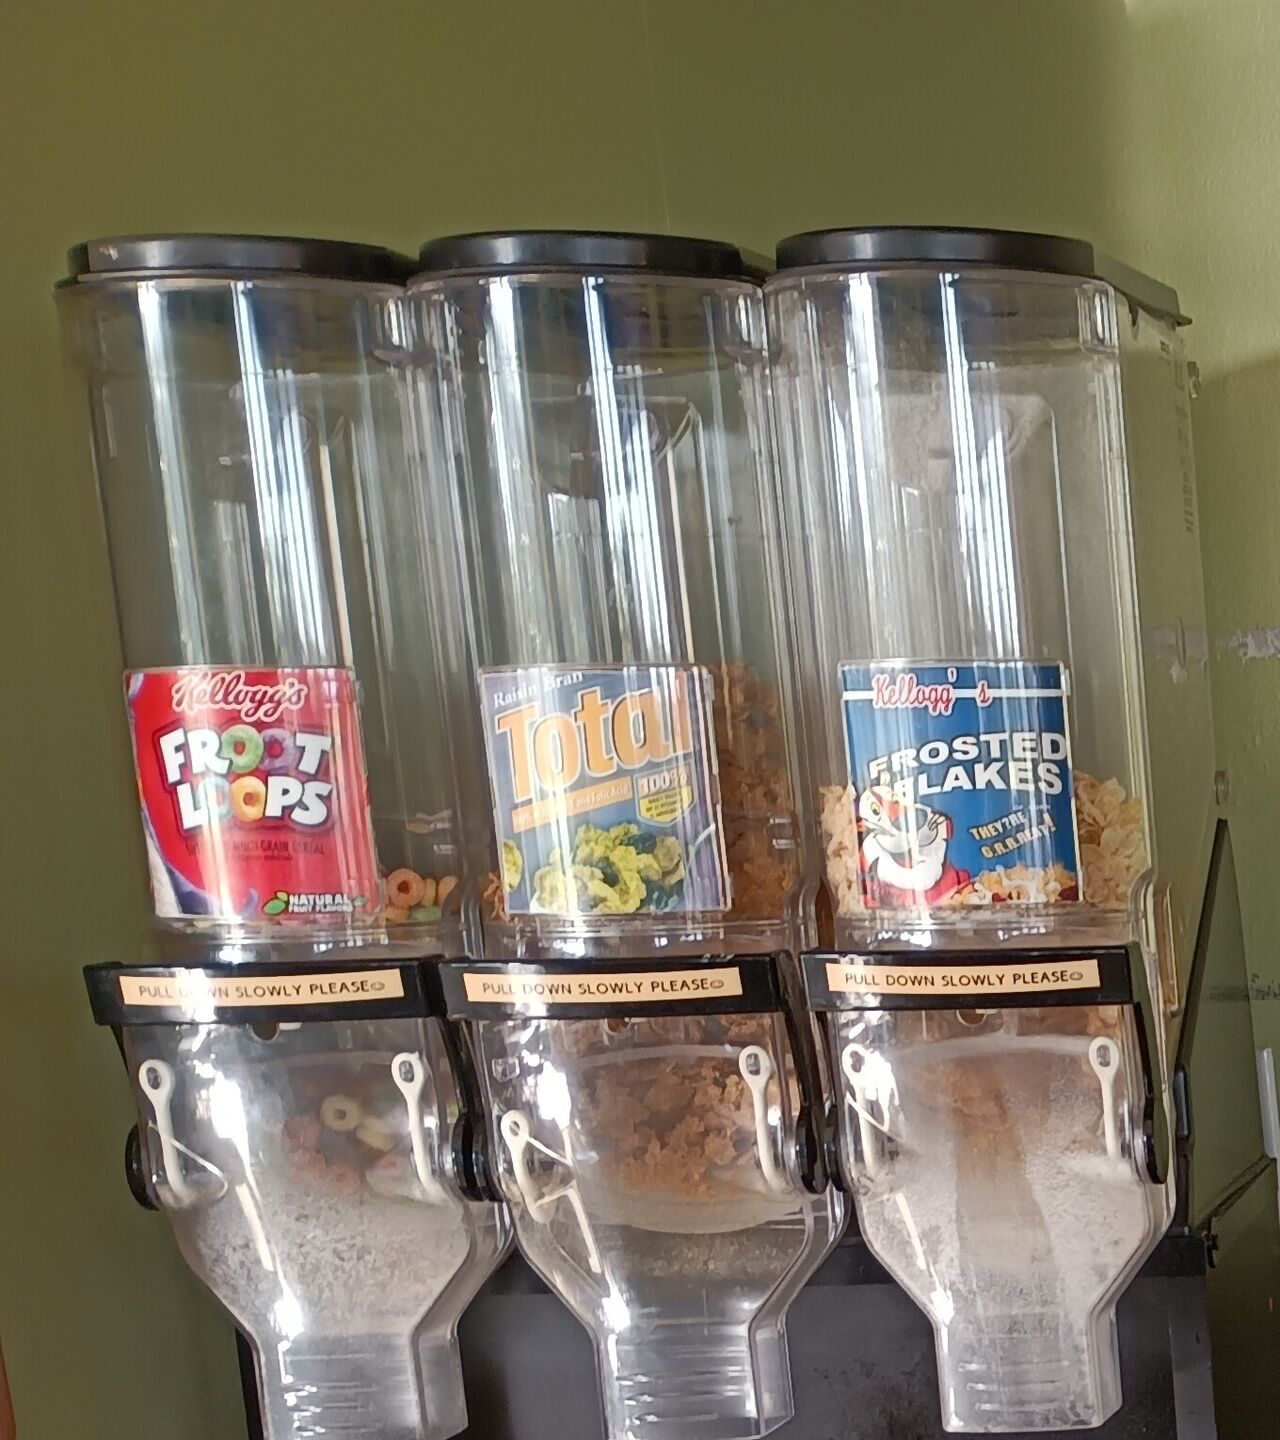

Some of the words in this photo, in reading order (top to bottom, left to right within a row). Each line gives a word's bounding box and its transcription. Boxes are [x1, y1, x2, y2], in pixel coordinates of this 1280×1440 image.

[172, 670, 306, 722] Kellogg's
[493, 680, 538, 708] Raisin
[543, 671, 583, 692] Bran
[159, 724, 332, 784] FROOT
[495, 671, 694, 803] Total
[868, 731, 1067, 780] FROSTED
[176, 776, 332, 830] LOOPS
[289, 894, 350, 906] NATURAL
[139, 984, 170, 998] PULL
[180, 984, 230, 999] DWN
[236, 983, 302, 998] SLOWLY
[310, 979, 371, 995] PLEASE
[483, 982, 516, 995] PULL
[523, 982, 572, 995] DOWN
[579, 981, 643, 995] SLOWLY
[651, 977, 709, 993] PLEASE
[845, 972, 880, 987] PULL
[886, 973, 935, 987] DOWN
[942, 973, 1006, 987] SLOWLY
[1013, 970, 1069, 985] PLEASE
